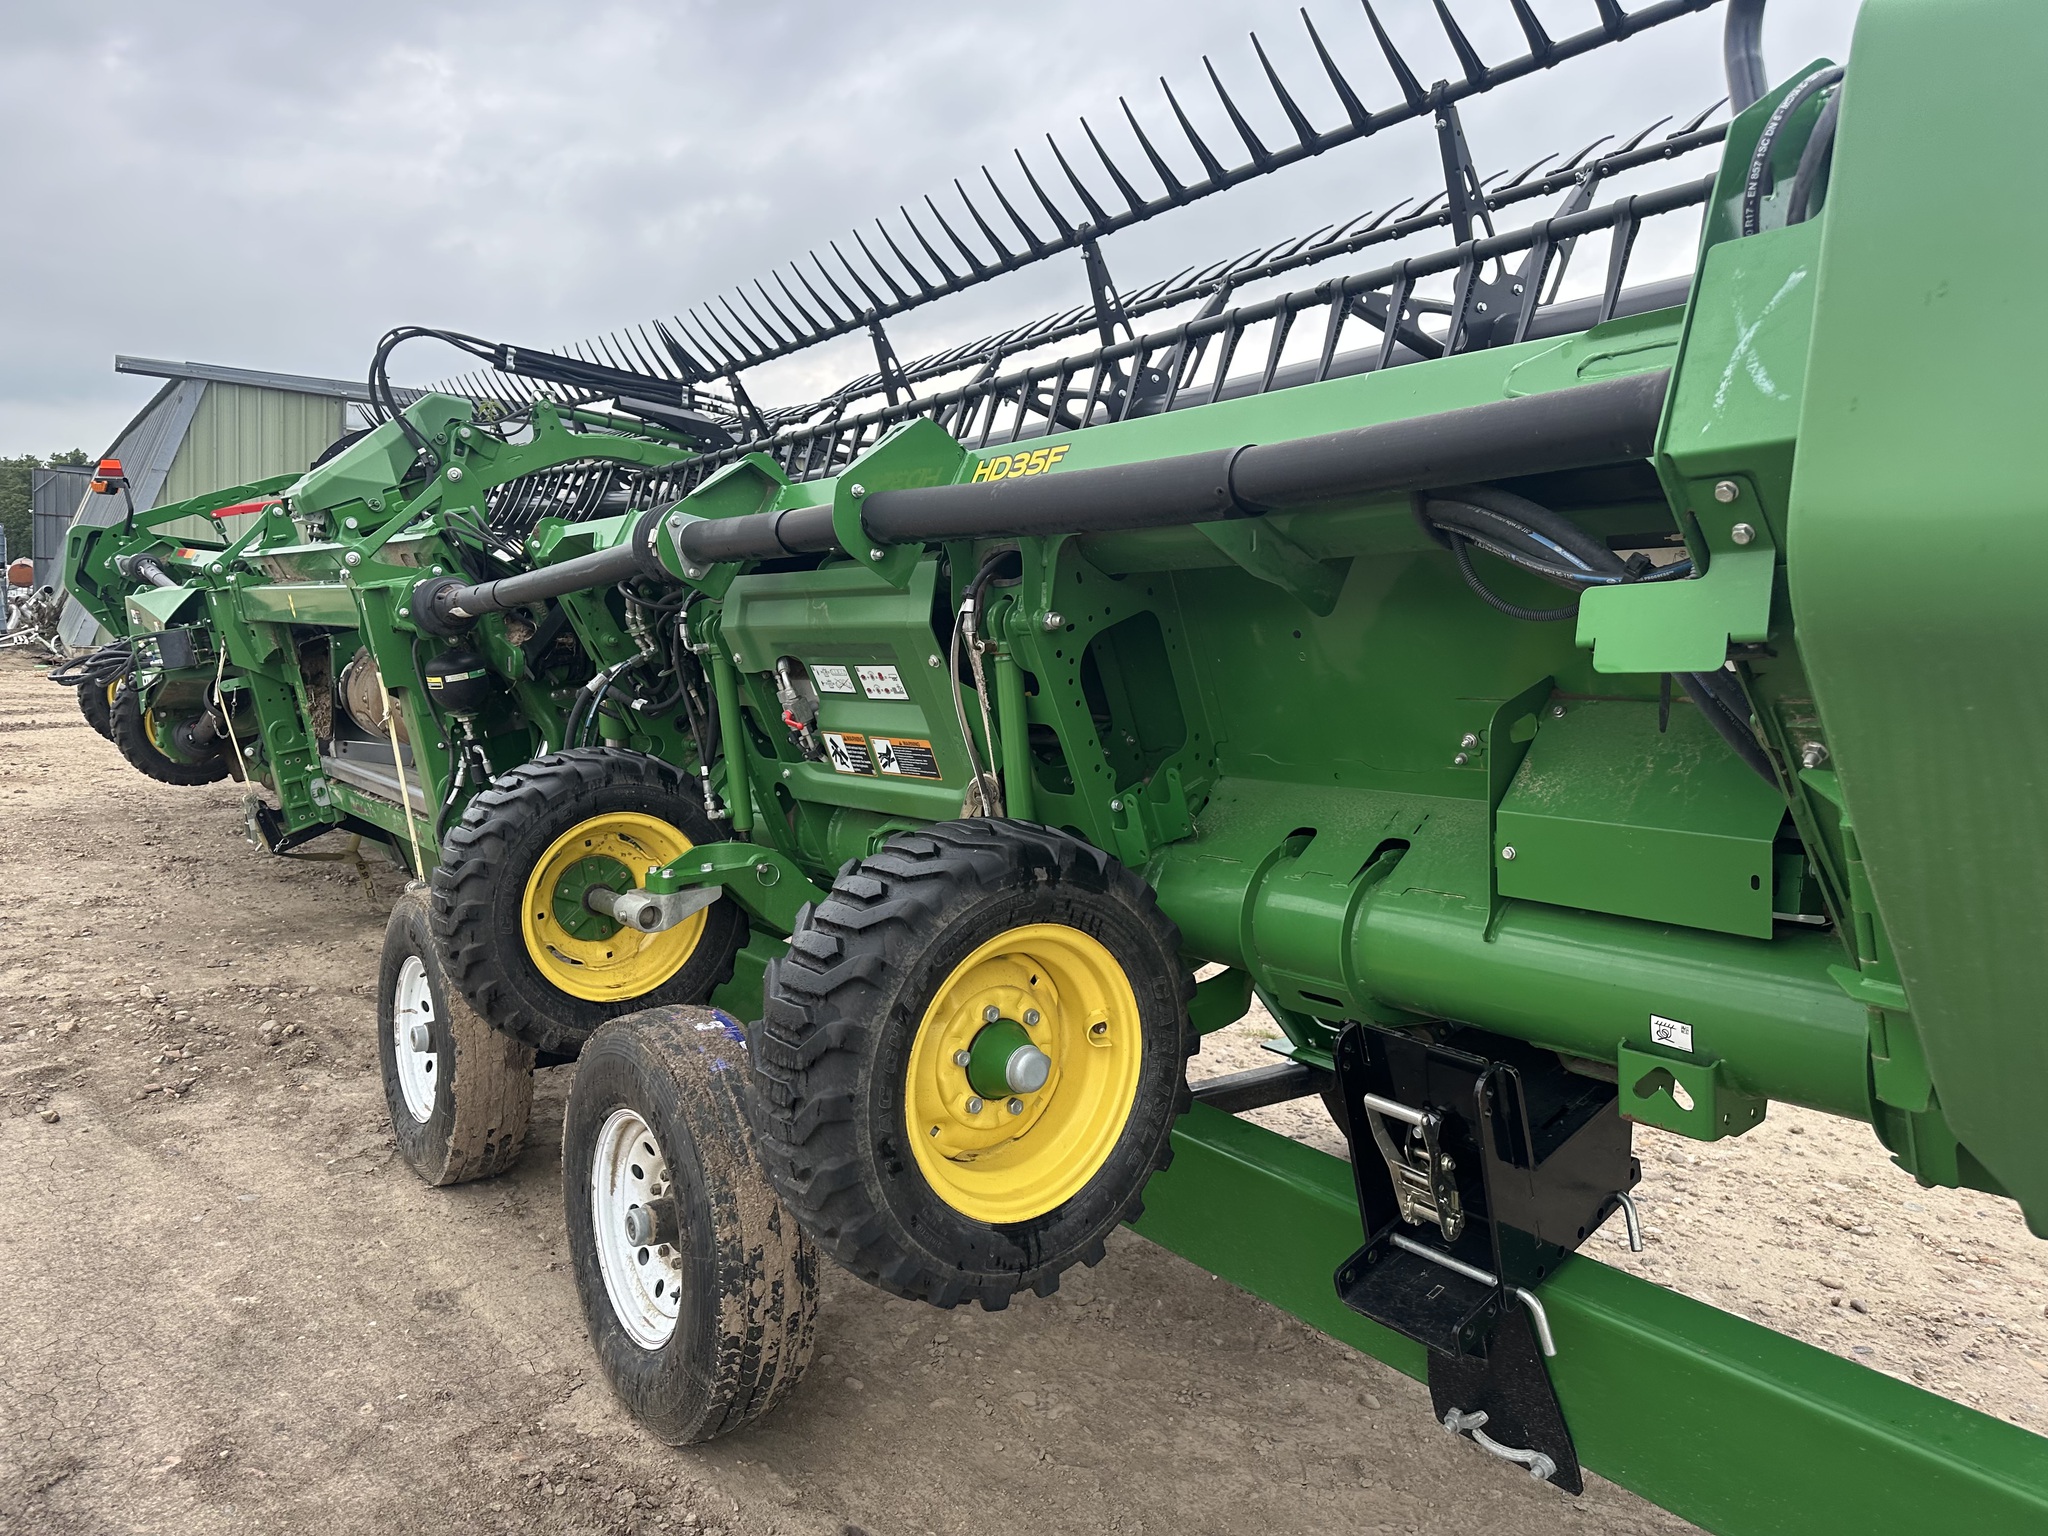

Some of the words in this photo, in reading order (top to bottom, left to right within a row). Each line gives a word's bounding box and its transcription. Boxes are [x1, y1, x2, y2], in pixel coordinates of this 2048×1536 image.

[1764, 122, 1779, 137] DN
[1757, 138, 1771, 157] 1SC
[1750, 161, 1762, 180] 857
[1747, 181, 1758, 198] EN
[1744, 208, 1754, 228] R17
[970, 443, 1072, 483] HD35F
[1126, 975, 1175, 1178] CARLISLE
